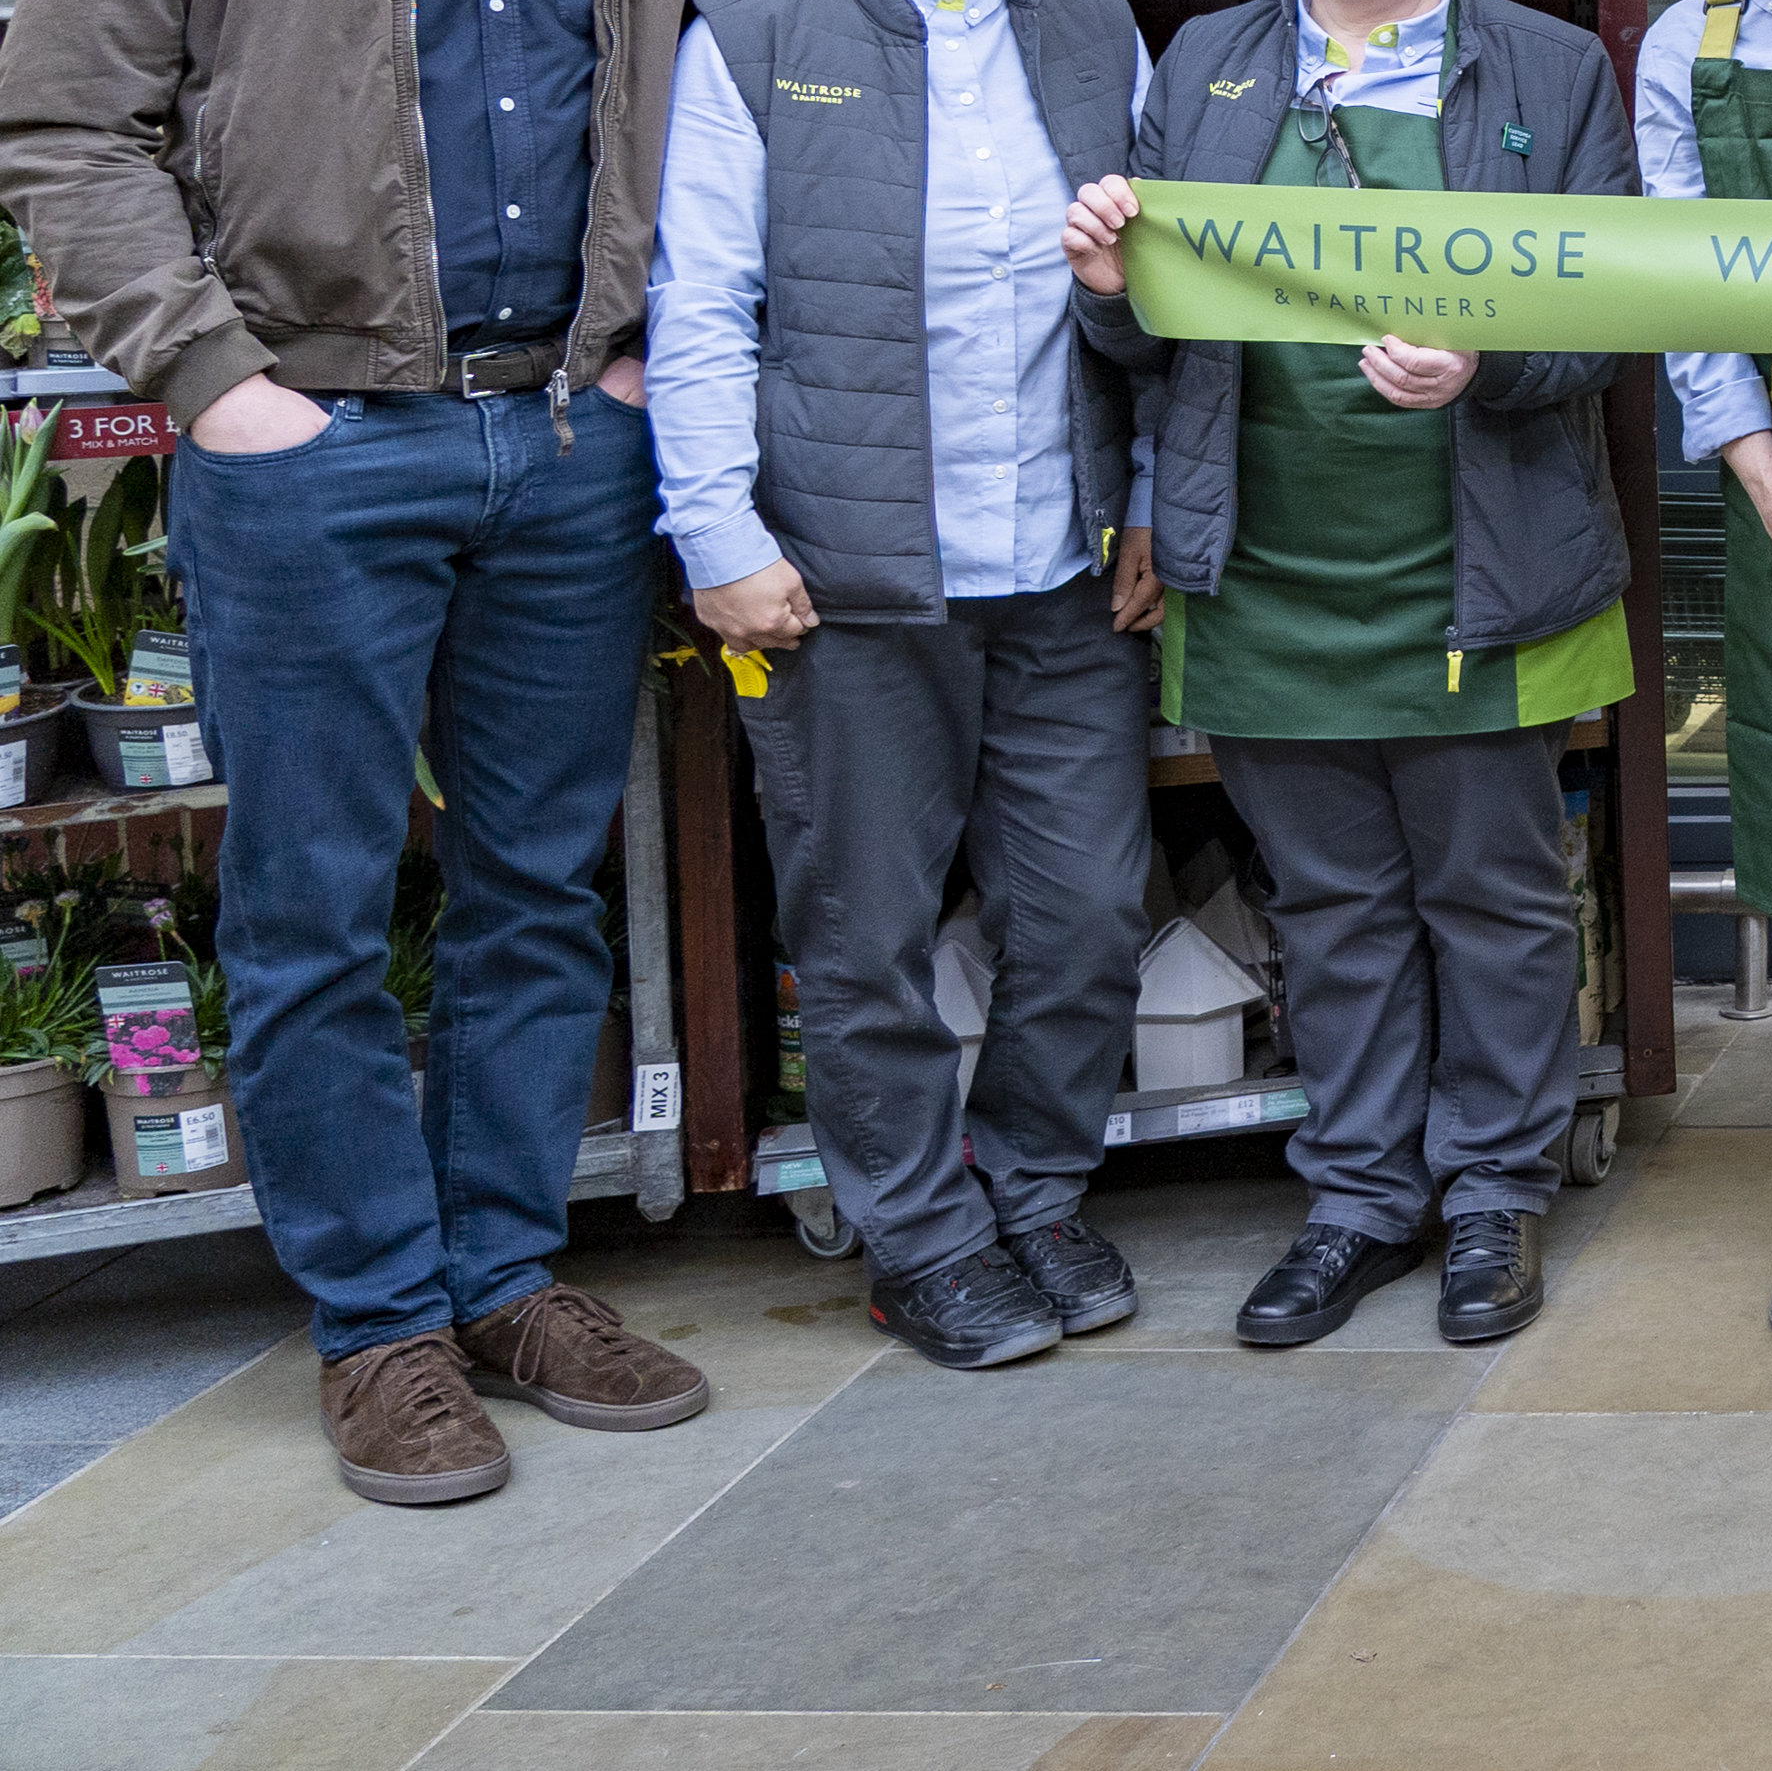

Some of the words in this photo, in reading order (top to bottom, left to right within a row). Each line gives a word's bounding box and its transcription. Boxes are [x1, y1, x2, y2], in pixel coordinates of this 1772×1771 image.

[776, 78, 862, 98] WAITROSE
[799, 94, 843, 104] PARTNERS
[1176, 217, 1587, 280] WAITROSE
[1274, 288, 1292, 307] &
[1307, 291, 1498, 320] PARTNERS
[69, 419, 84, 439] 3
[95, 415, 156, 437] FOR
[82, 440, 104, 449] MIX
[106, 440, 115, 448] &
[117, 437, 159, 447] MATCH
[120, 729, 158, 737] WAITROSE
[112, 968, 169, 978] WAITROSE
[653, 1071, 669, 1081] 3
[650, 1086, 669, 1119] MIX
[1237, 1099, 1254, 1109] £12
[136, 1116, 176, 1125] WAITROSE
[186, 1111, 215, 1126] £6.50
[1109, 1116, 1125, 1126] £10
